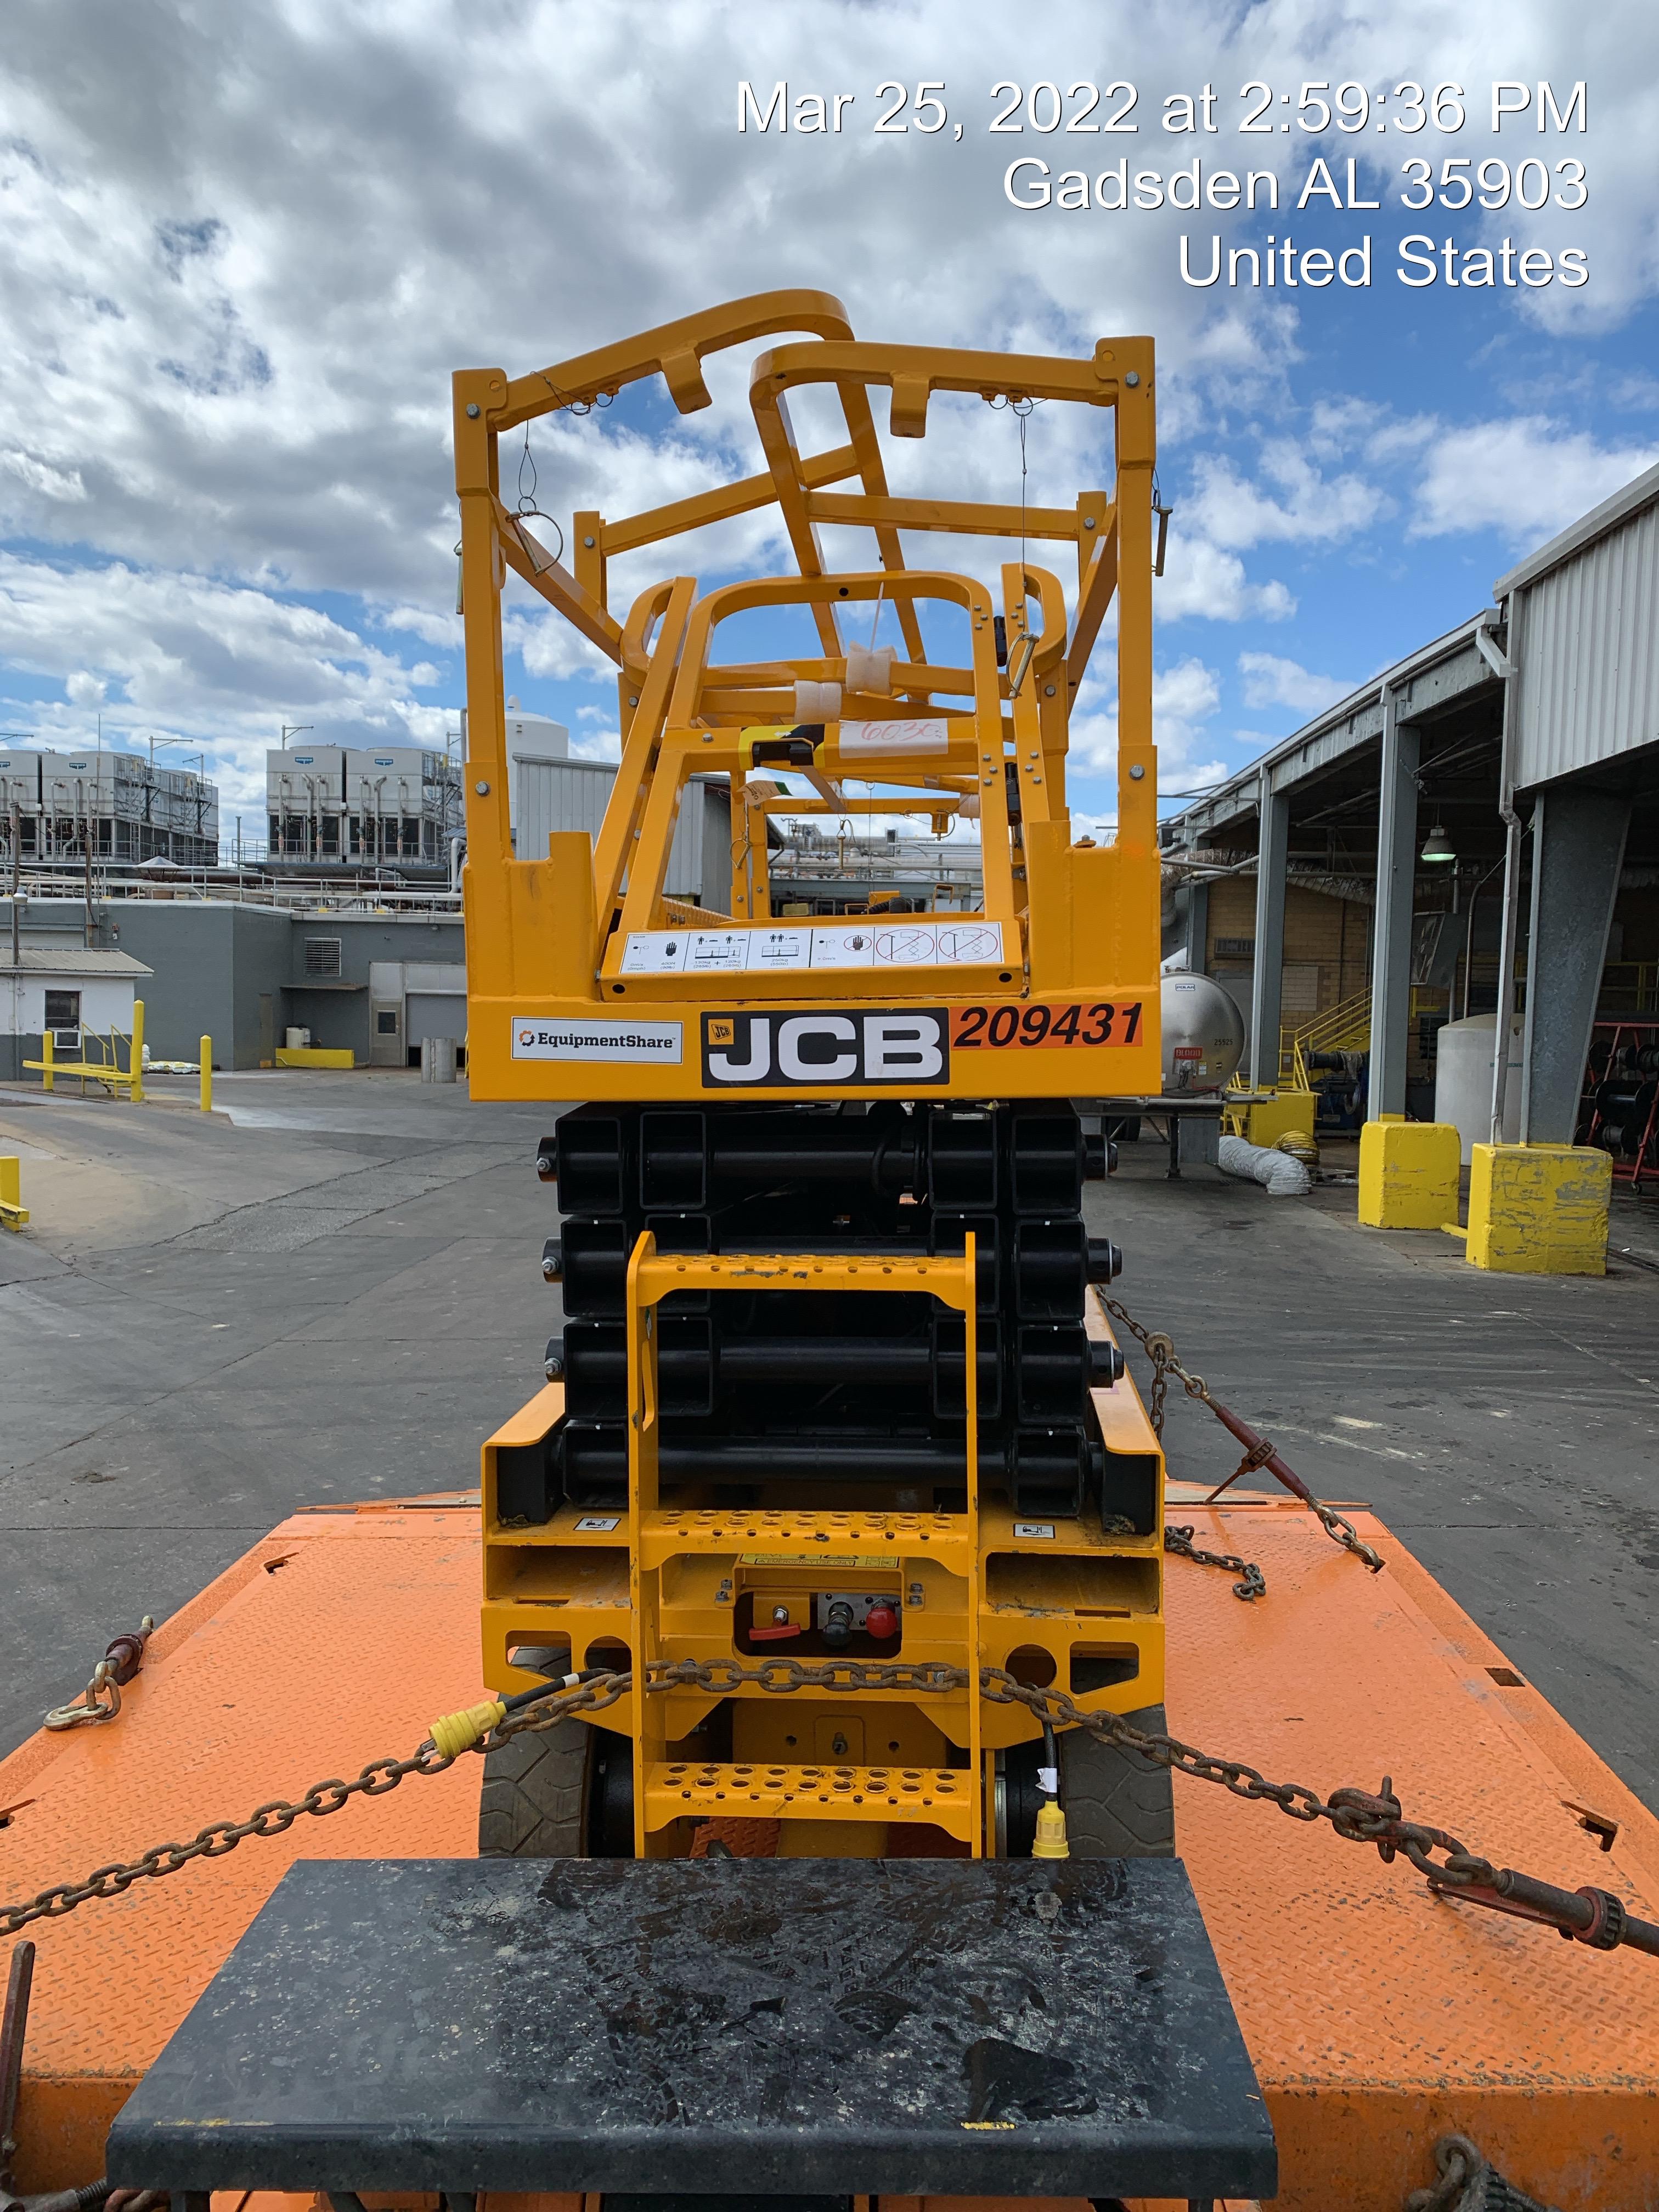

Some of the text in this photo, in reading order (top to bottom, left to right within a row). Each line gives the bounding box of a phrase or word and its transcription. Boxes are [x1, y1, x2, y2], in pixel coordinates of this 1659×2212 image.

[861, 721, 941, 741] 6030
[714, 1025, 730, 1038] JCB
[953, 1002, 1143, 1047] 209431
[538, 1032, 673, 1048] EquipmentShare
[708, 1016, 943, 1081] JCB
